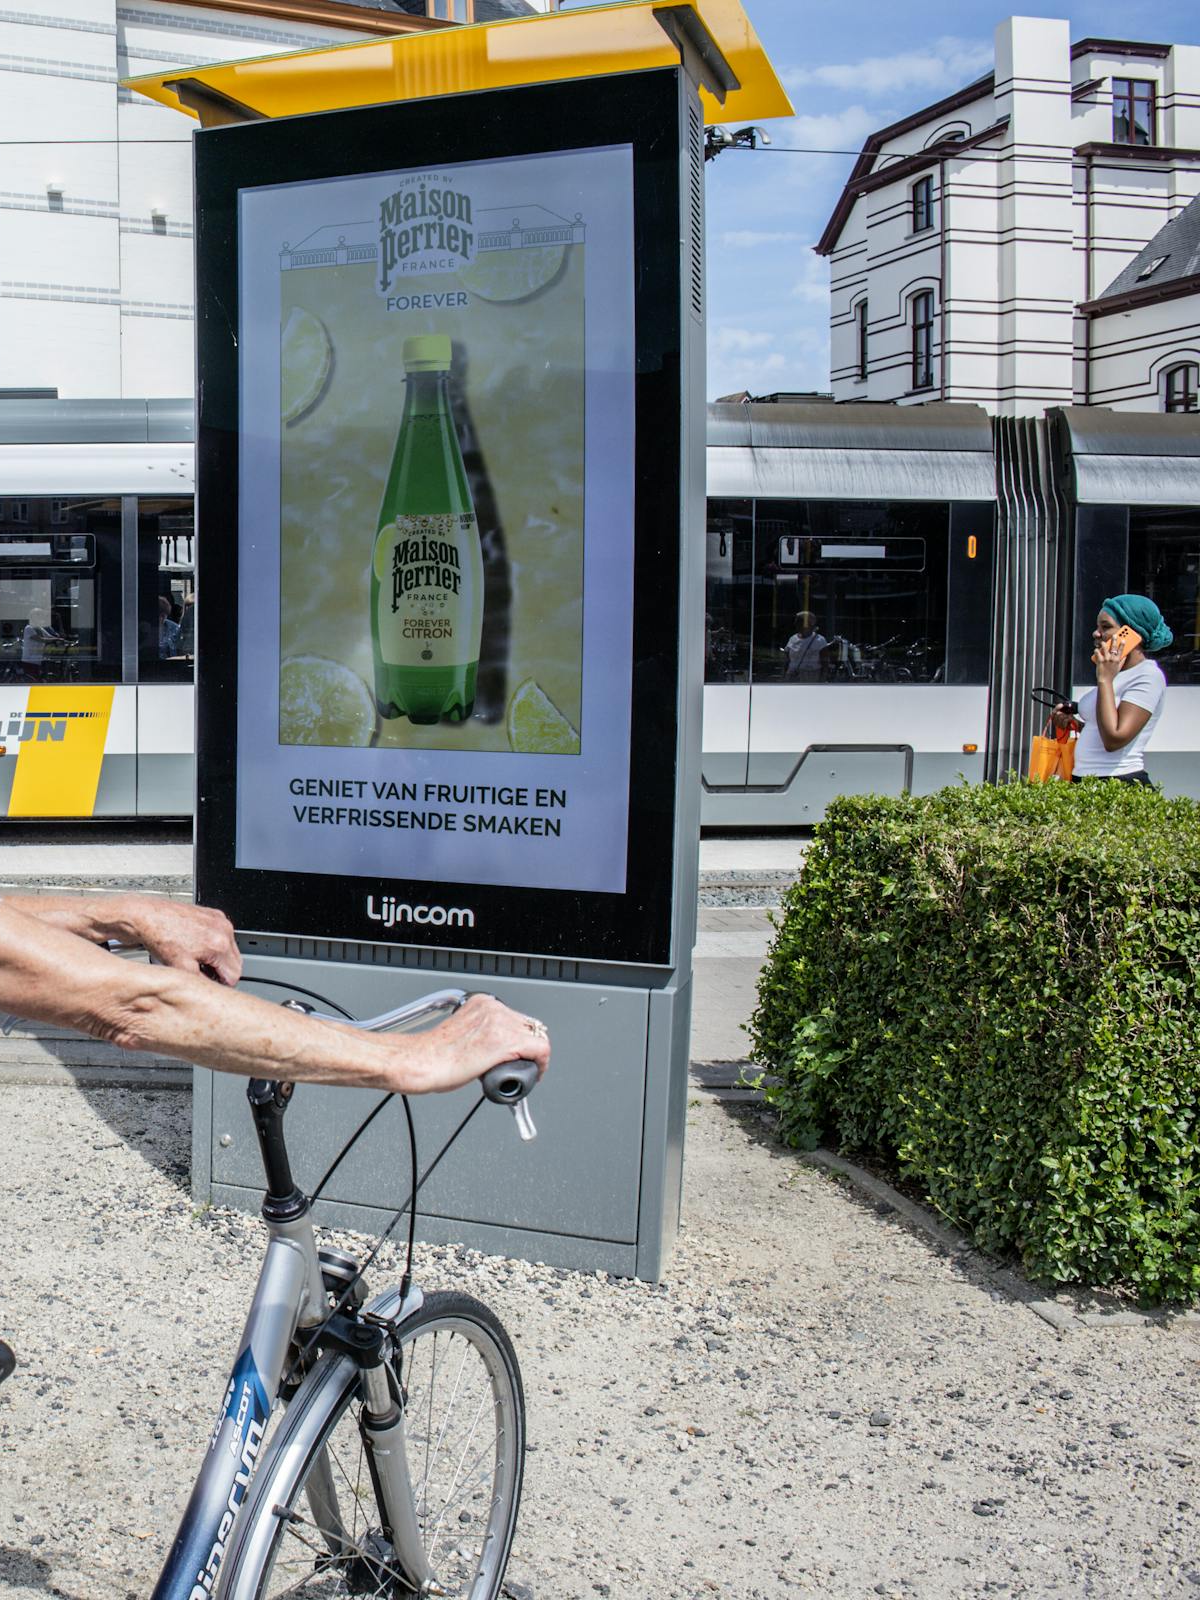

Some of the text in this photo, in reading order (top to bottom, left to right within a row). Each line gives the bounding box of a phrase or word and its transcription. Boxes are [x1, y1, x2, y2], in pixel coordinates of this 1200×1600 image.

[400, 174, 439, 187] CREATED
[379, 183, 473, 234] Maison
[402, 258, 455, 272] FRANCE
[386, 292, 468, 311] FOREVER
[392, 535, 461, 570] Maison
[407, 593, 448, 601] FRANCE
[402, 628, 453, 639] CITRON
[403, 619, 450, 628] FOREVER
[289, 778, 567, 808] GENIET VAN FRUITIGE EN
[293, 805, 562, 837] VERFRISSENDE SMAKEN
[366, 895, 475, 928] Lijncom
[228, 1380, 254, 1458] ASCOT
